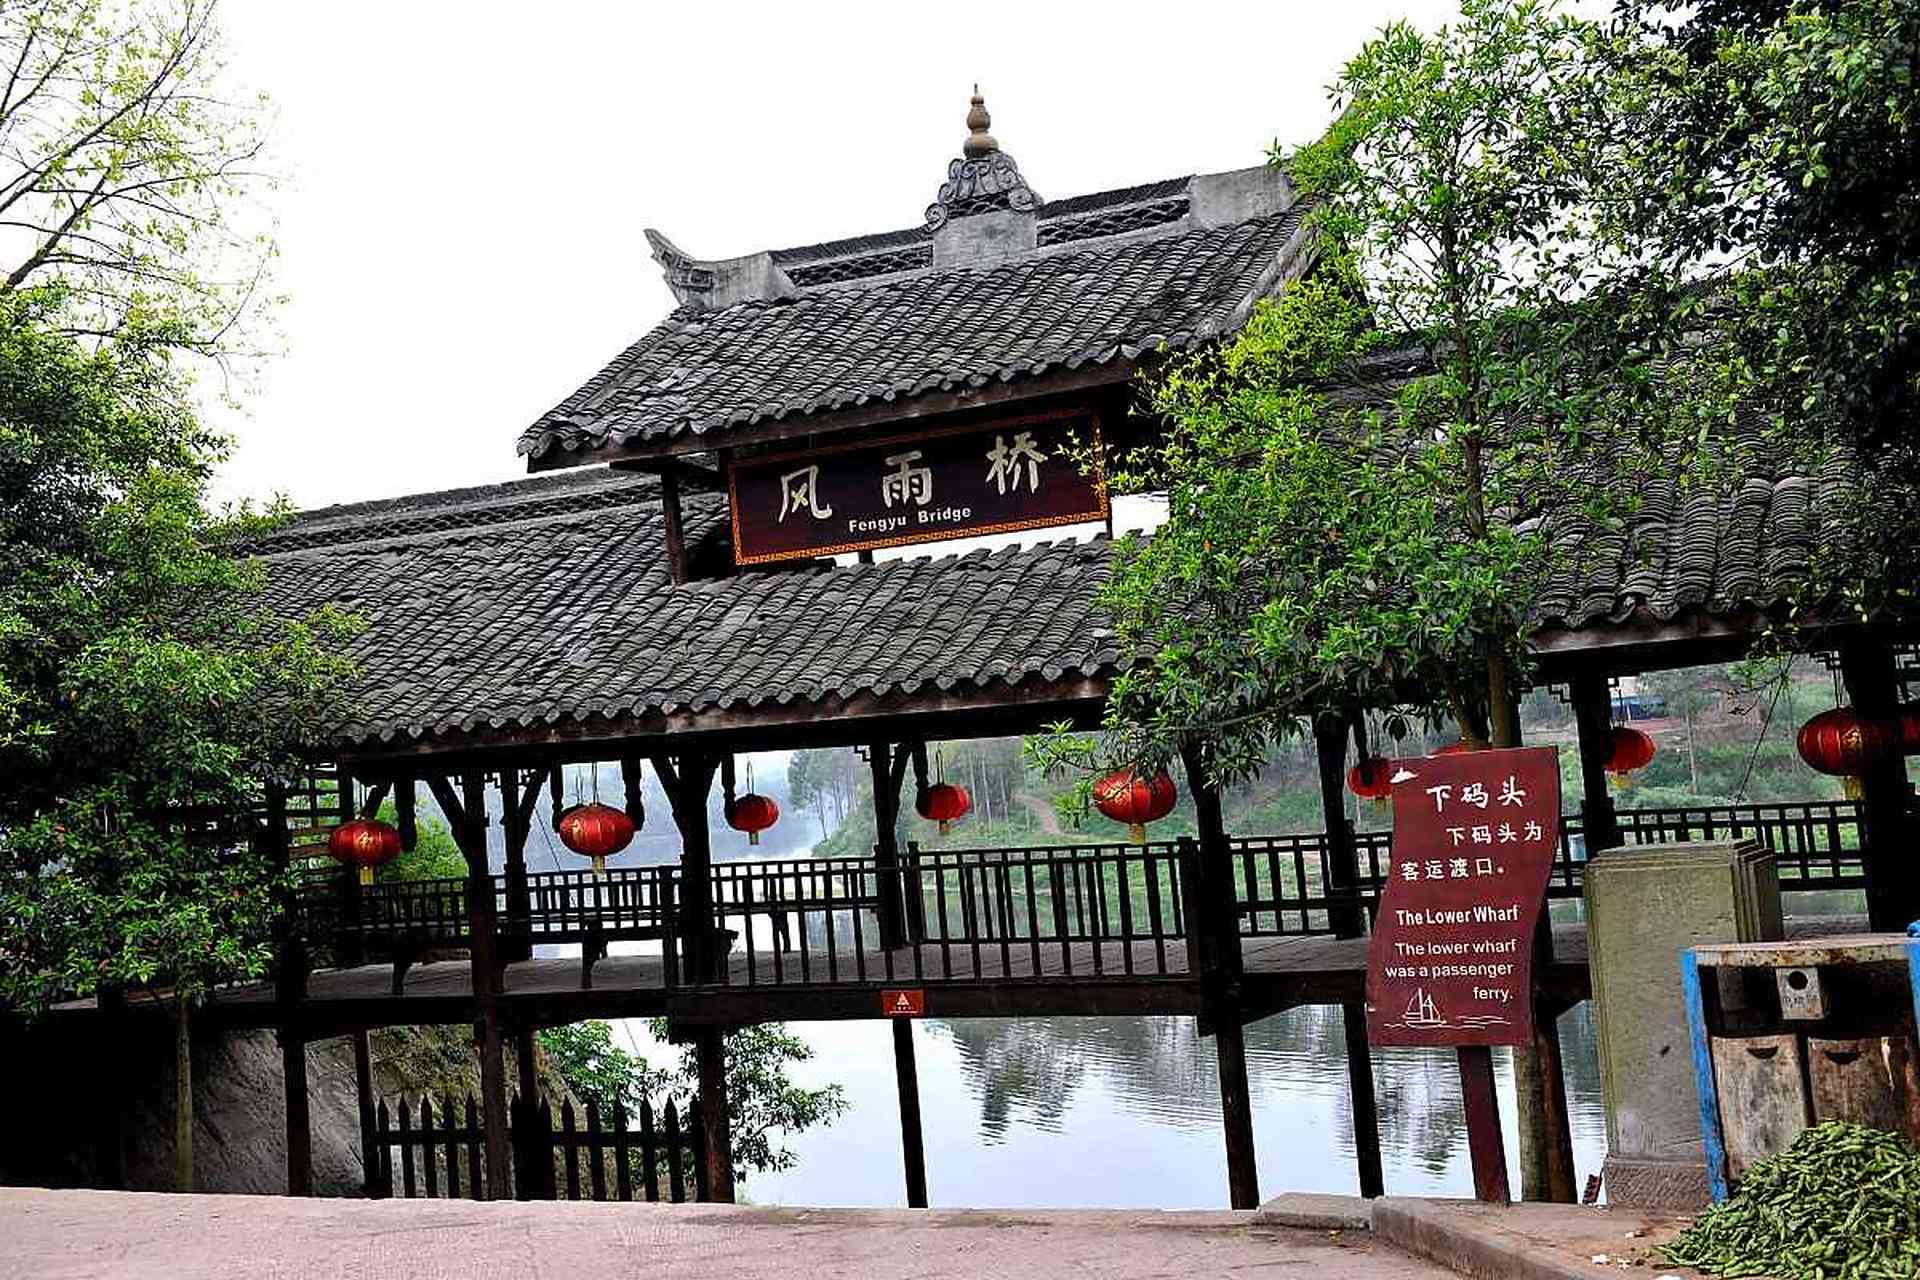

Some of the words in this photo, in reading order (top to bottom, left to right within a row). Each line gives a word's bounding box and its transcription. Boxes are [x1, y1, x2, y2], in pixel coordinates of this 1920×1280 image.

[778, 431, 1048, 523] 风雨桥
[848, 516, 907, 534] Fengyu
[917, 506, 972, 524] Bridge
[1426, 775, 1526, 812] 下码头
[1446, 821, 1543, 846] 下码头为
[1395, 909, 1424, 925] The
[1426, 908, 1471, 925] Lower
[1473, 904, 1520, 923] Wharf
[1394, 942, 1425, 956] The
[1427, 942, 1470, 955] lower
[1472, 938, 1517, 954] wharf
[1385, 966, 1416, 978] was
[1418, 966, 1428, 977] a
[1432, 963, 1514, 979] passenger
[1473, 986, 1513, 1003] ferry.
